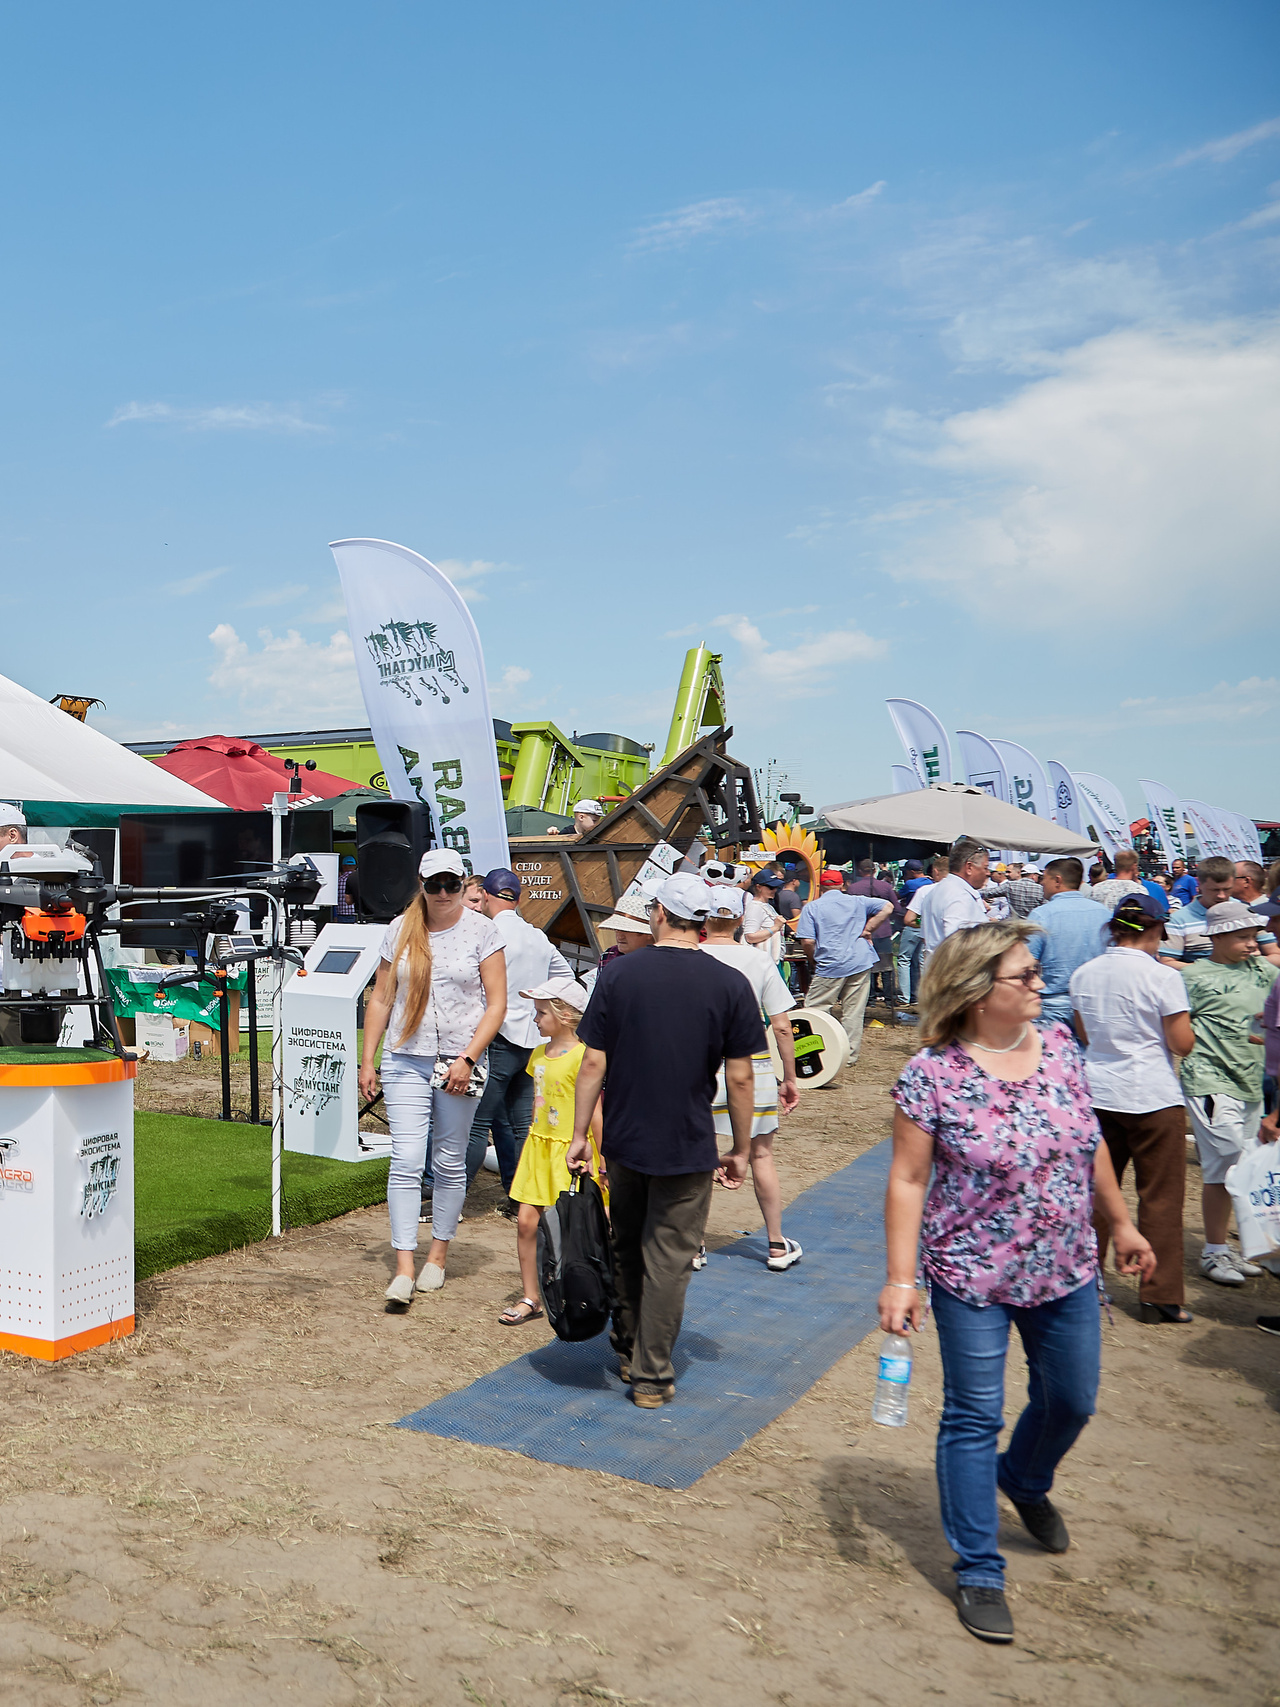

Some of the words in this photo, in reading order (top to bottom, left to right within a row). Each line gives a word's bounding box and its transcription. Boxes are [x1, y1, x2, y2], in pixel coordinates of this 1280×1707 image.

[516, 863, 542, 871] СЕЛО
[521, 876, 552, 886] БУДЕТ
[529, 890, 562, 900] ЖИТЬ!
[291, 1027, 342, 1040] ЦИФРОВАЯ
[287, 1037, 347, 1052] ЭКОСИСТЕМА
[305, 1079, 340, 1094] МУСТАНГ
[82, 1133, 119, 1147] ЦИФРОВАЯ
[80, 1142, 122, 1158] ЭКОСИСТЕМА
[93, 1178, 117, 1193] МУСТАНГ
